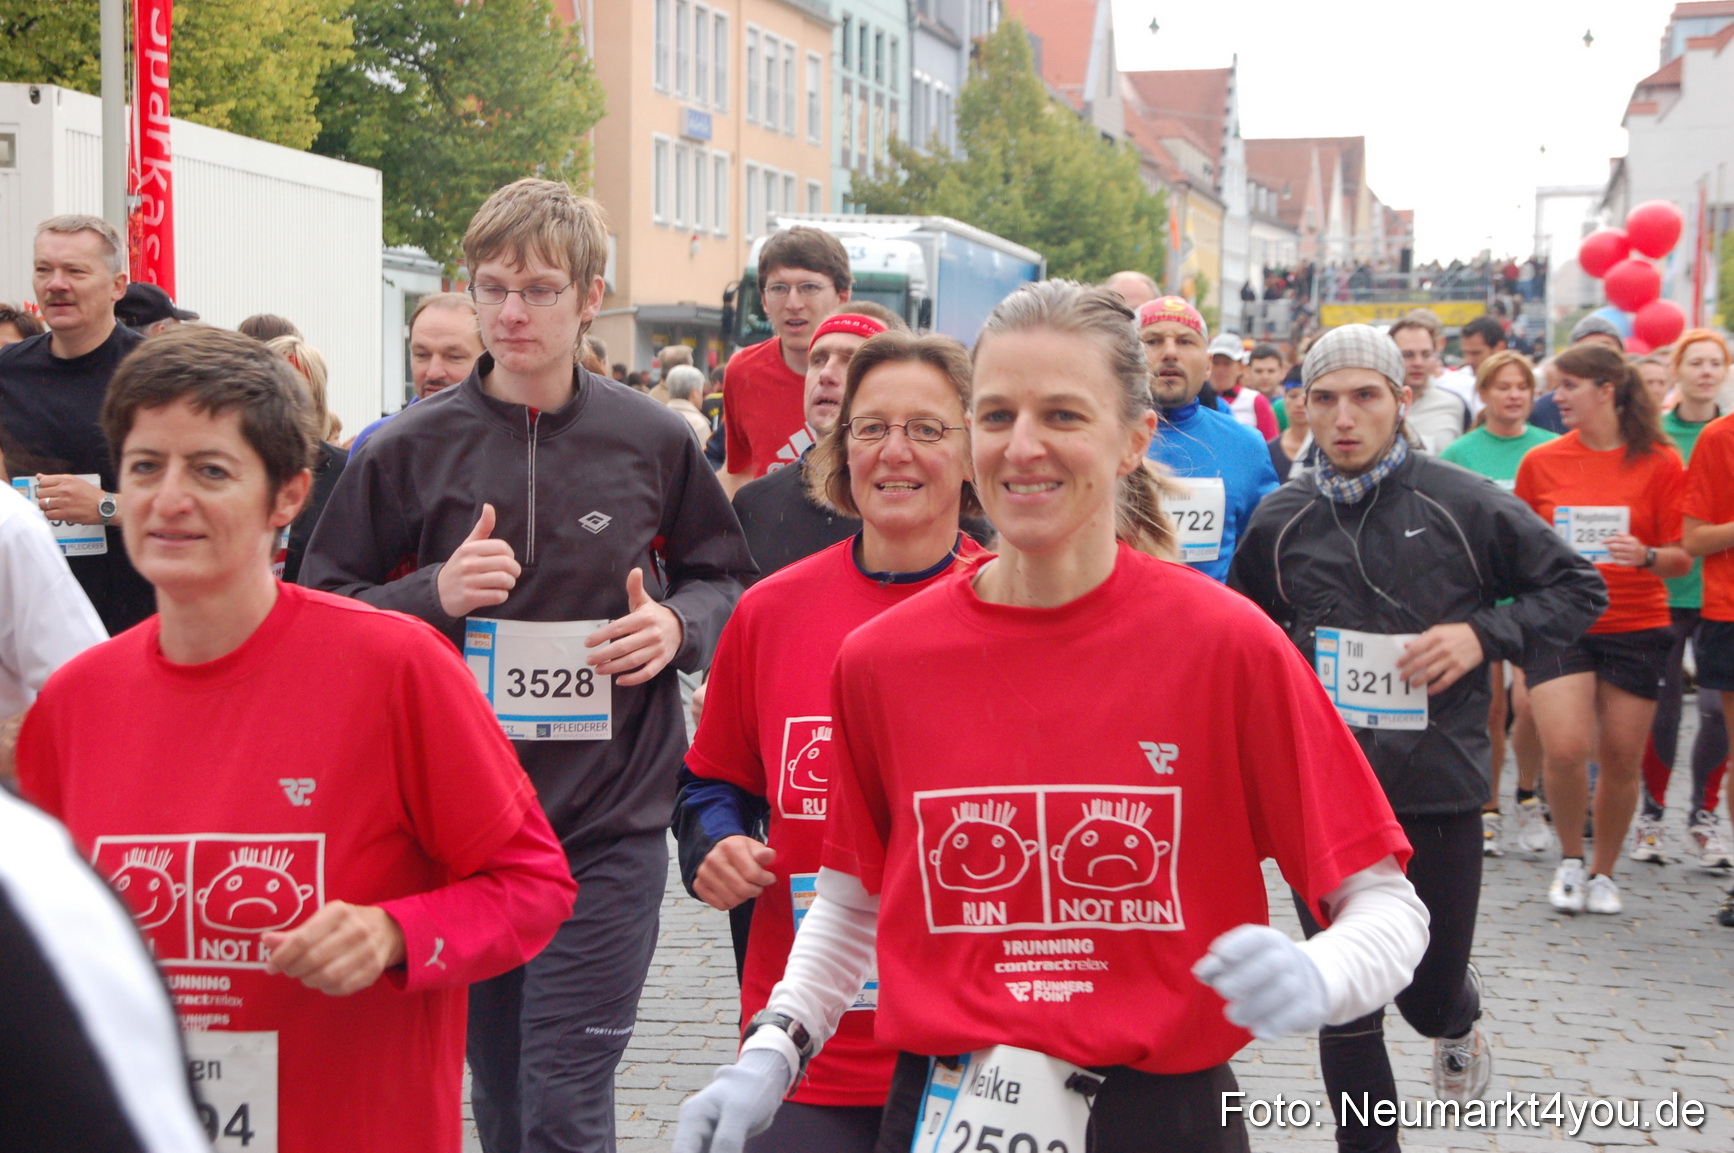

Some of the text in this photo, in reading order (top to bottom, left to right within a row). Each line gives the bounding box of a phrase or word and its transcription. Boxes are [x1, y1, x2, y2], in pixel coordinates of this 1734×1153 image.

[1162, 510, 1215, 531] 722
[1346, 640, 1364, 658] Till
[507, 667, 595, 698] 3528
[552, 722, 608, 733] PFLEIDERER
[802, 797, 828, 815] RU
[962, 901, 1008, 925] RUN
[1058, 898, 1174, 924] NOT RUN
[201, 937, 252, 961] NOT
[994, 958, 1110, 973] contractrelax
[167, 974, 232, 991] UNNING
[1033, 979, 1094, 993] RUNNERS
[189, 1059, 222, 1081] en
[197, 1102, 256, 1147] 94
